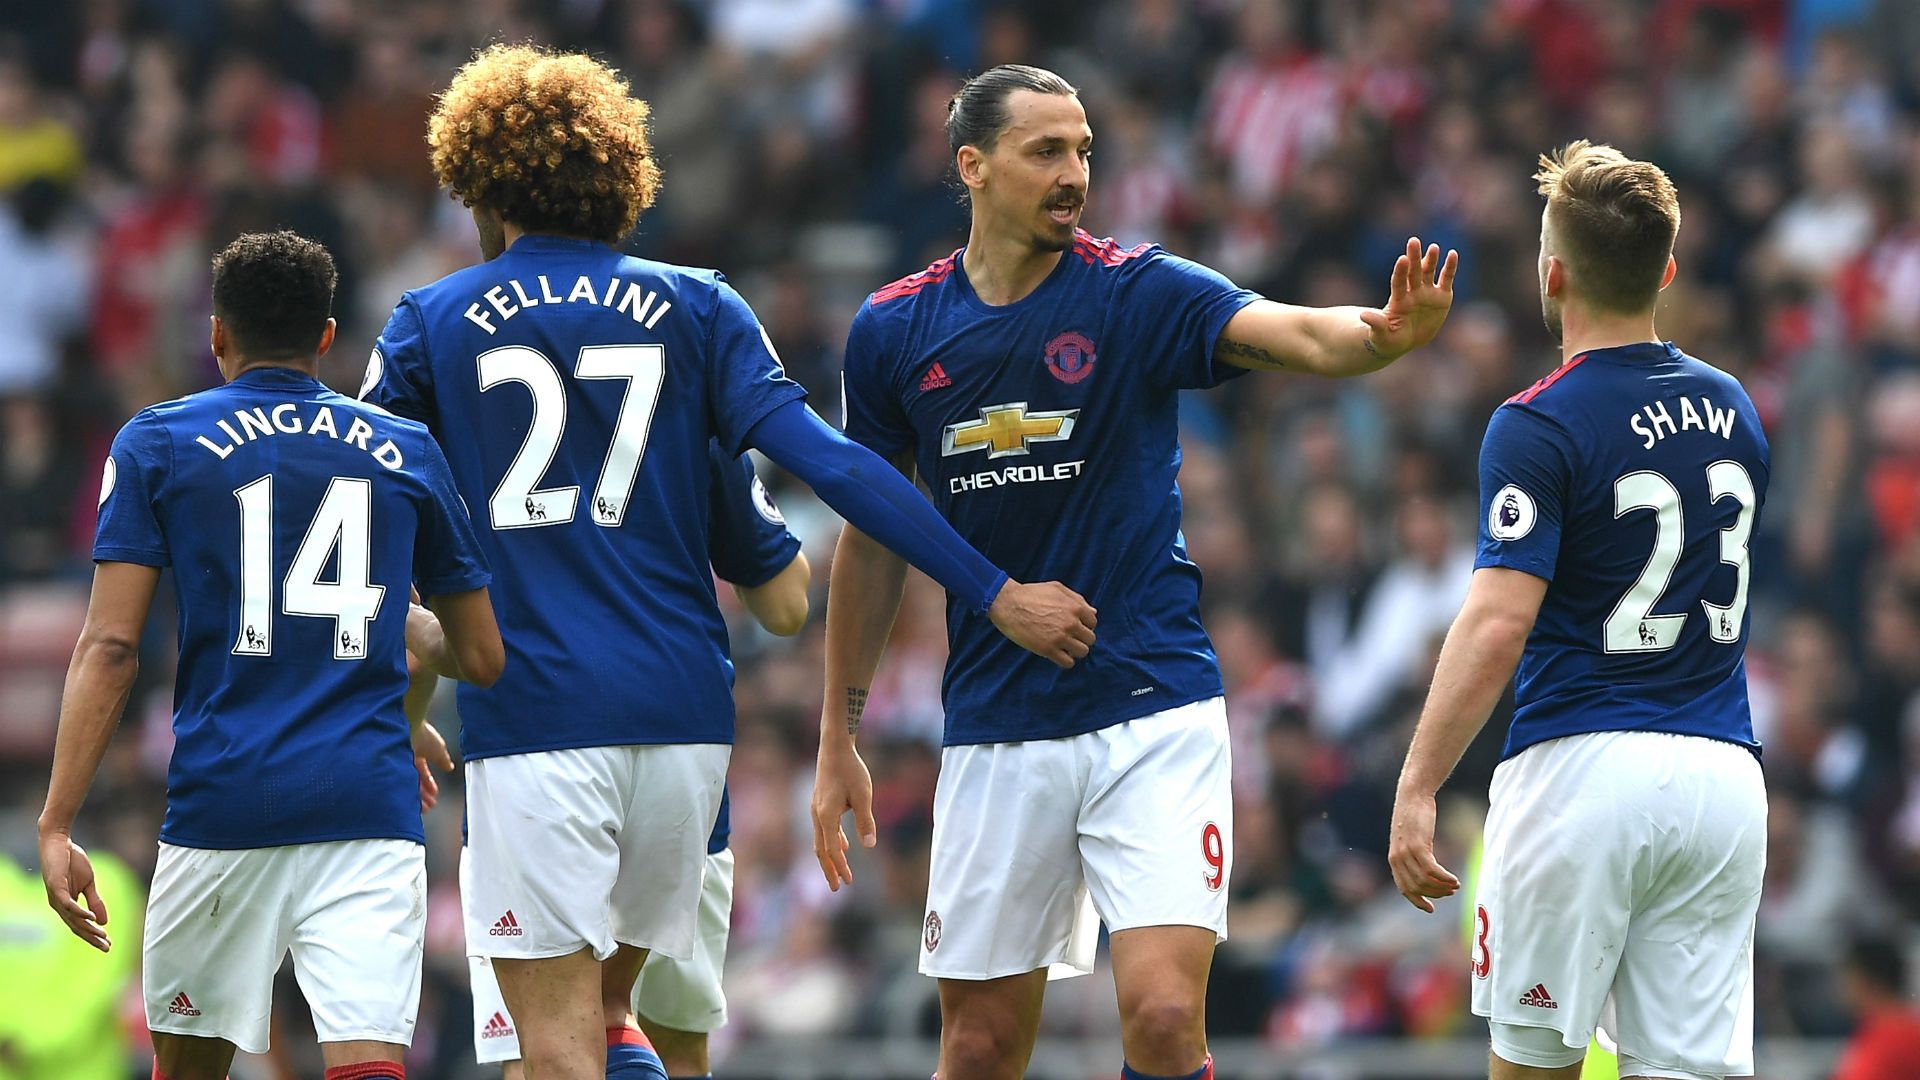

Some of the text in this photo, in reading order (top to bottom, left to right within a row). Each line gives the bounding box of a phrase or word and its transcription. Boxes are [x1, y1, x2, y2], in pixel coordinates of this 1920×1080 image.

[463, 275, 672, 336] FELLAINI
[919, 377, 952, 392] adidas
[195, 403, 404, 471] LINGARD
[475, 344, 666, 531] 27
[1629, 396, 1736, 450] SHAW
[949, 459, 1086, 494] CHEVROLET
[231, 473, 387, 661] 14
[1602, 459, 1757, 655] 23
[1201, 820, 1224, 893] 9
[489, 924, 523, 937] adidas
[1471, 903, 1491, 981] 3
[168, 1004, 202, 1017] adidas
[1519, 996, 1559, 1010] adidas
[481, 1027, 514, 1040] adidas
